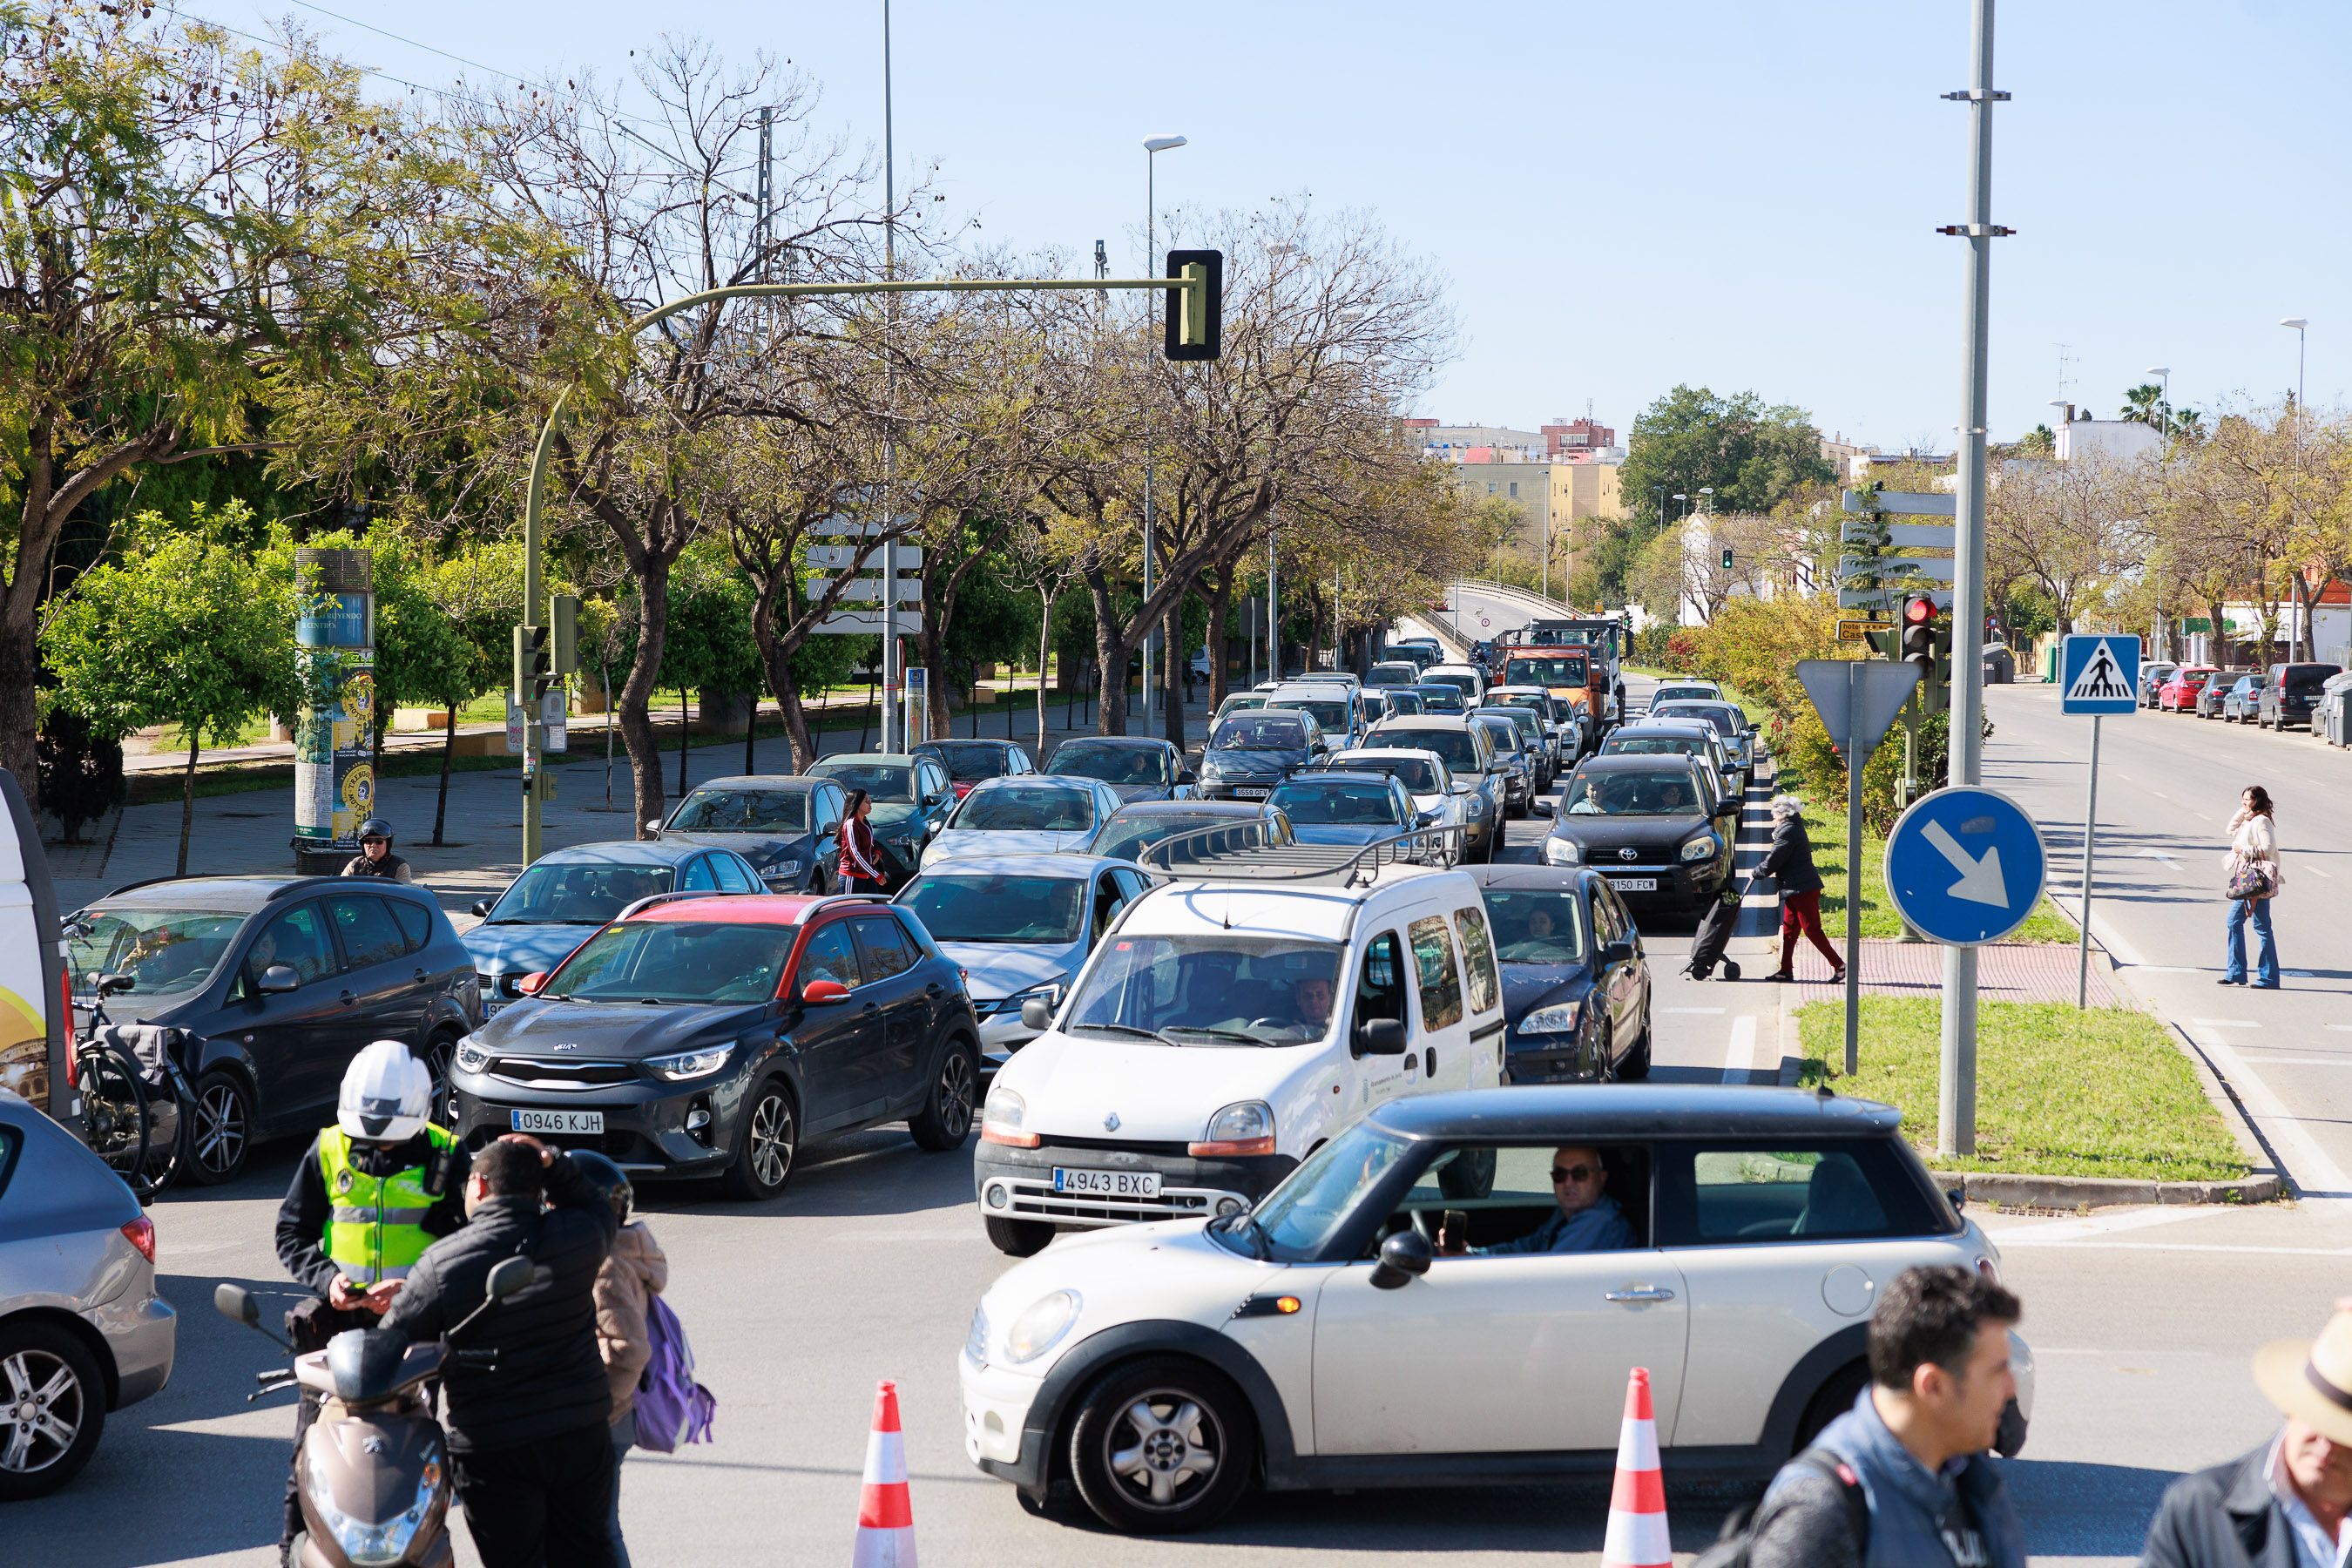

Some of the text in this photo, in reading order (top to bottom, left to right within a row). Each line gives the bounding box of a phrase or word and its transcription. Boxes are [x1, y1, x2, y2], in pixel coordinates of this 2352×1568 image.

[348, 702, 367, 721] MOTOR
[348, 794, 367, 811] MOTOR
[523, 1113, 601, 1131] 0946 KJH
[1065, 1173, 1152, 1193] 4943 BXC
